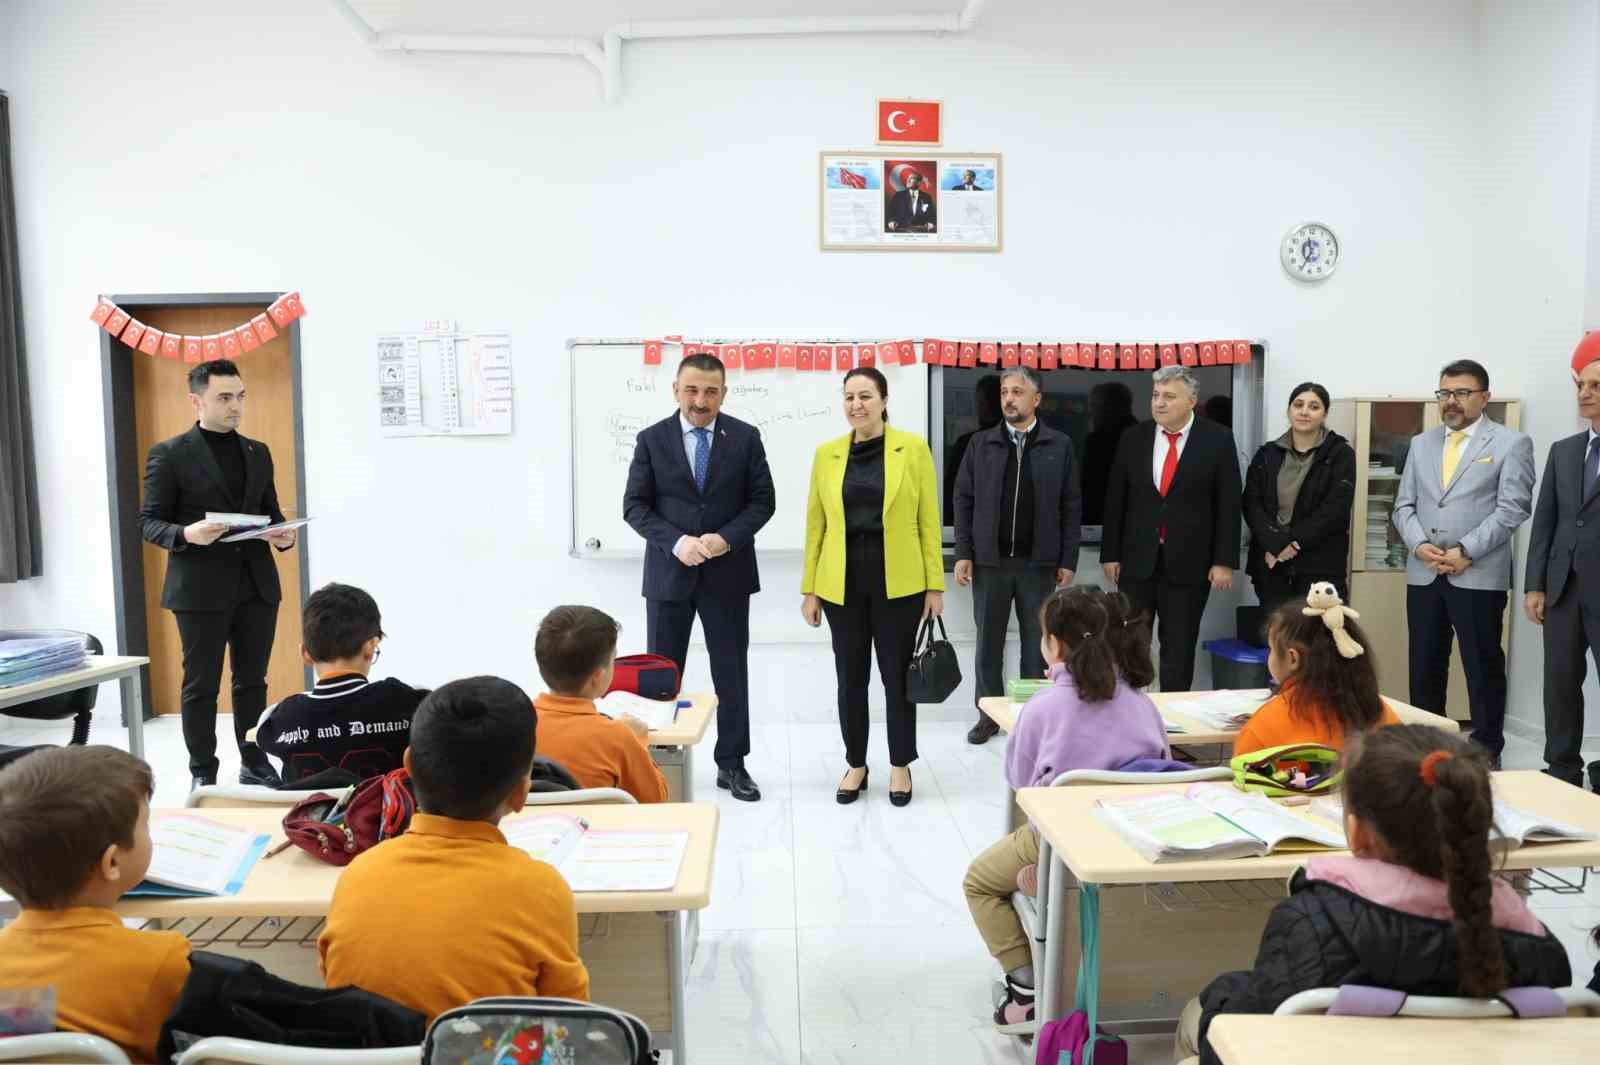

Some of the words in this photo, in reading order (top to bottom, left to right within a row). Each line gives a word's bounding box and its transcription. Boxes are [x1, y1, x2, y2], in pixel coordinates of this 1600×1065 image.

[1308, 228, 1316, 236] 12
[317, 723, 341, 739] and
[348, 719, 410, 736] Demand
